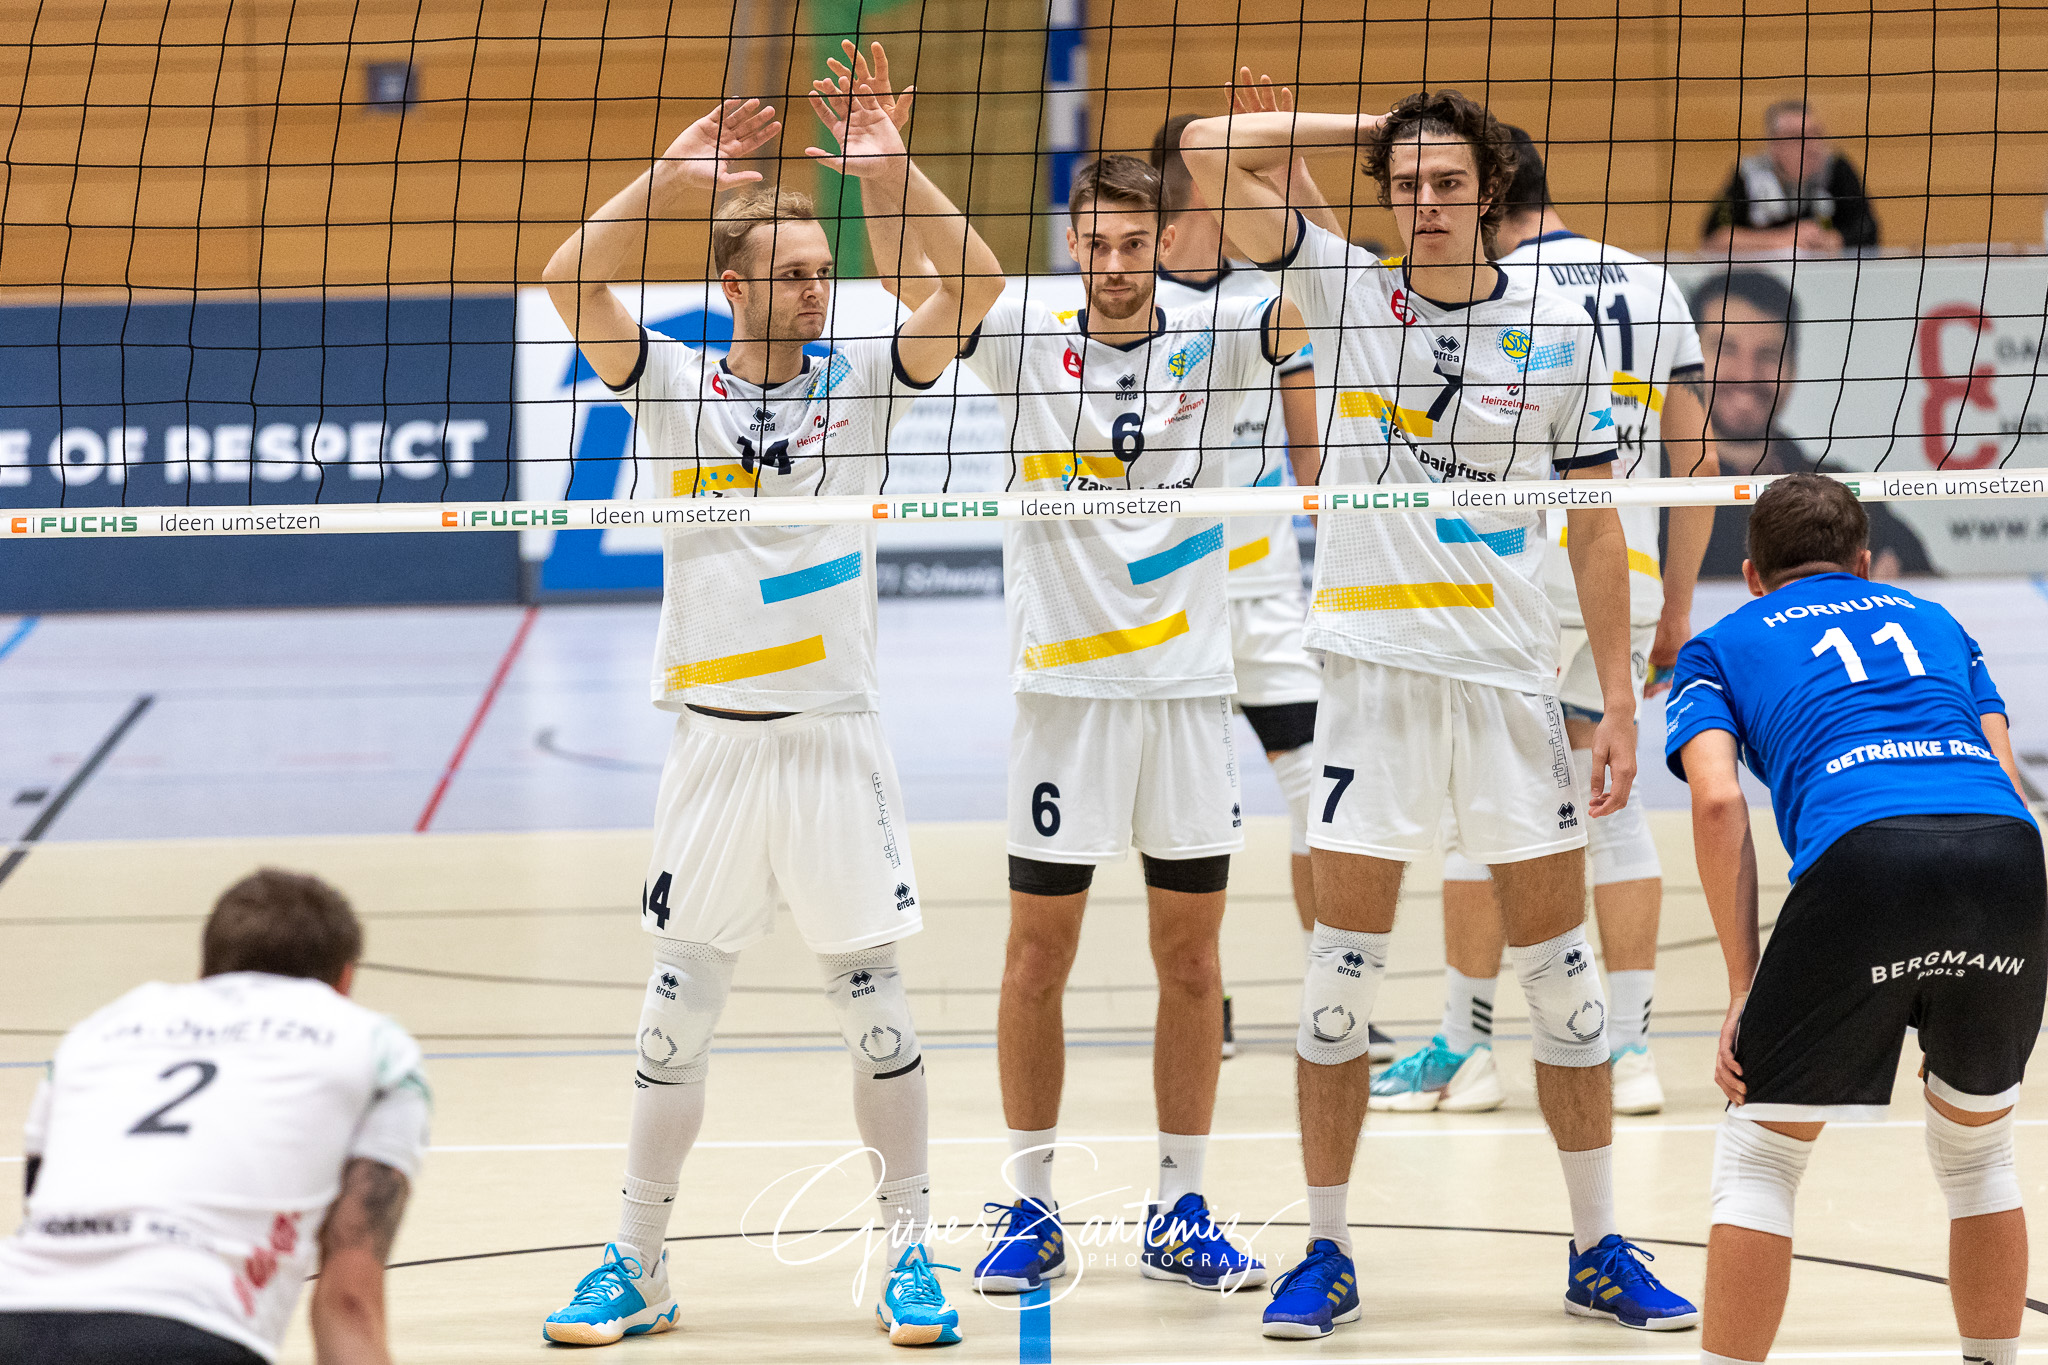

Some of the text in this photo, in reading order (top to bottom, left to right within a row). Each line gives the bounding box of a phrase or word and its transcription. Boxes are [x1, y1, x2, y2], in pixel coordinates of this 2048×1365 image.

[1433, 349, 1460, 363] errea
[1426, 363, 1462, 422] 7
[1481, 394, 1540, 412] Heinzelmann
[1112, 412, 1145, 462] 6
[49, 427, 147, 487] OF
[164, 420, 488, 484] RESPECT
[1420, 449, 1497, 482] Daigfuss
[1884, 476, 2045, 497] Ideen umsetzen
[901, 497, 1182, 519] FUCHS Ideen umsetzen
[1332, 487, 1613, 510] FUCHS Ideen umsetzen
[41, 511, 321, 534] FUCHS Ideen umsetzen
[471, 505, 751, 527] FUCHS Ideen umsetzen
[1762, 594, 1916, 628] HORNUNG
[1811, 621, 1926, 683] 11
[1825, 739, 1944, 774] GETRÄNKE
[1322, 765, 1356, 823] 7
[1031, 781, 1061, 837] 6
[1559, 817, 1578, 830] errea
[896, 896, 916, 911] errea
[1336, 964, 1362, 979] errea
[1567, 960, 1589, 978] errea
[1871, 950, 2025, 984] BERGMANN
[1917, 967, 1966, 980] POOLS
[655, 984, 677, 1001] errea
[851, 983, 876, 999] errea
[125, 1057, 219, 1137] 2
